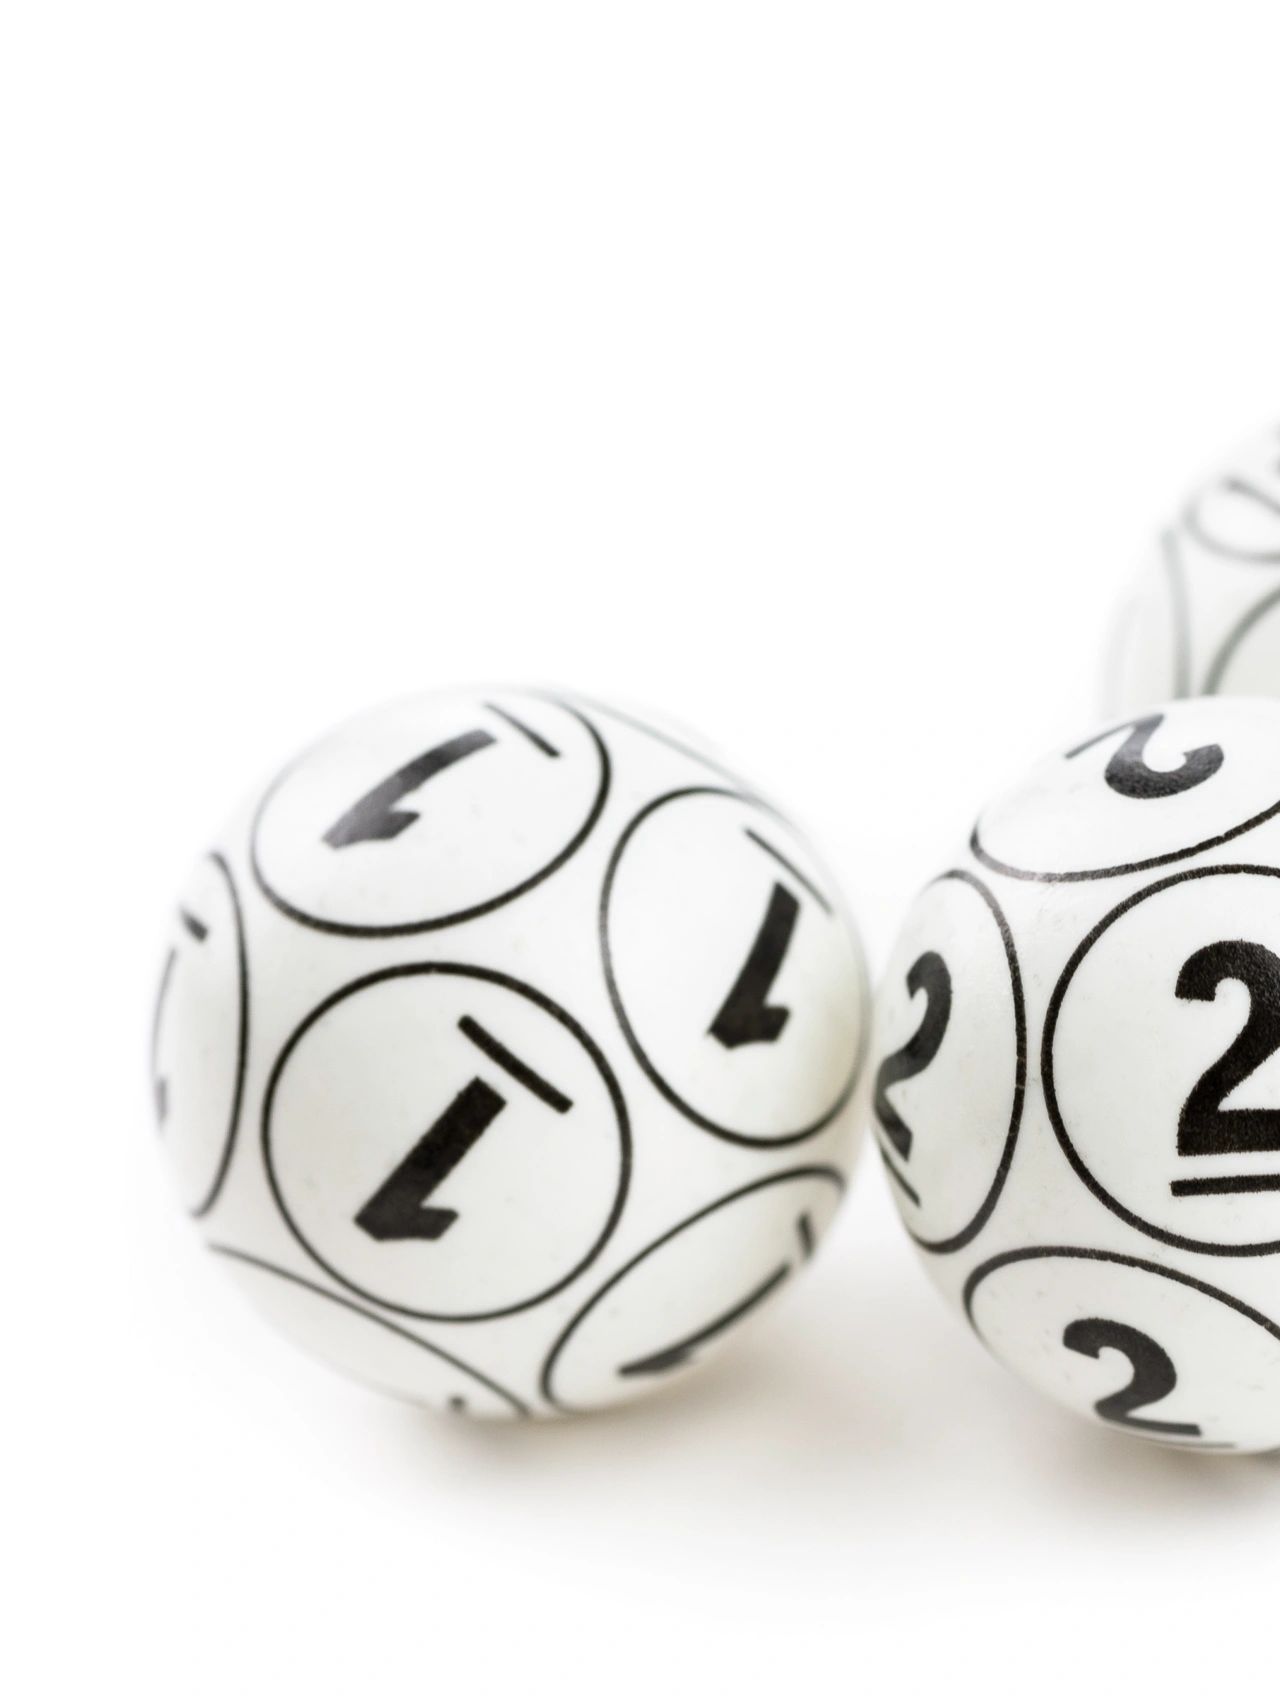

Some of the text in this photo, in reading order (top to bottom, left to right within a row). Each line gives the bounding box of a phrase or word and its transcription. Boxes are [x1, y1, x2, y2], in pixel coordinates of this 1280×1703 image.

[320, 727, 500, 851] 1
[1104, 712, 1225, 800] 2
[707, 882, 801, 1050] 1
[874, 950, 953, 1163] 2
[353, 1075, 508, 1243] 1
[1062, 1317, 1202, 1437] 2
